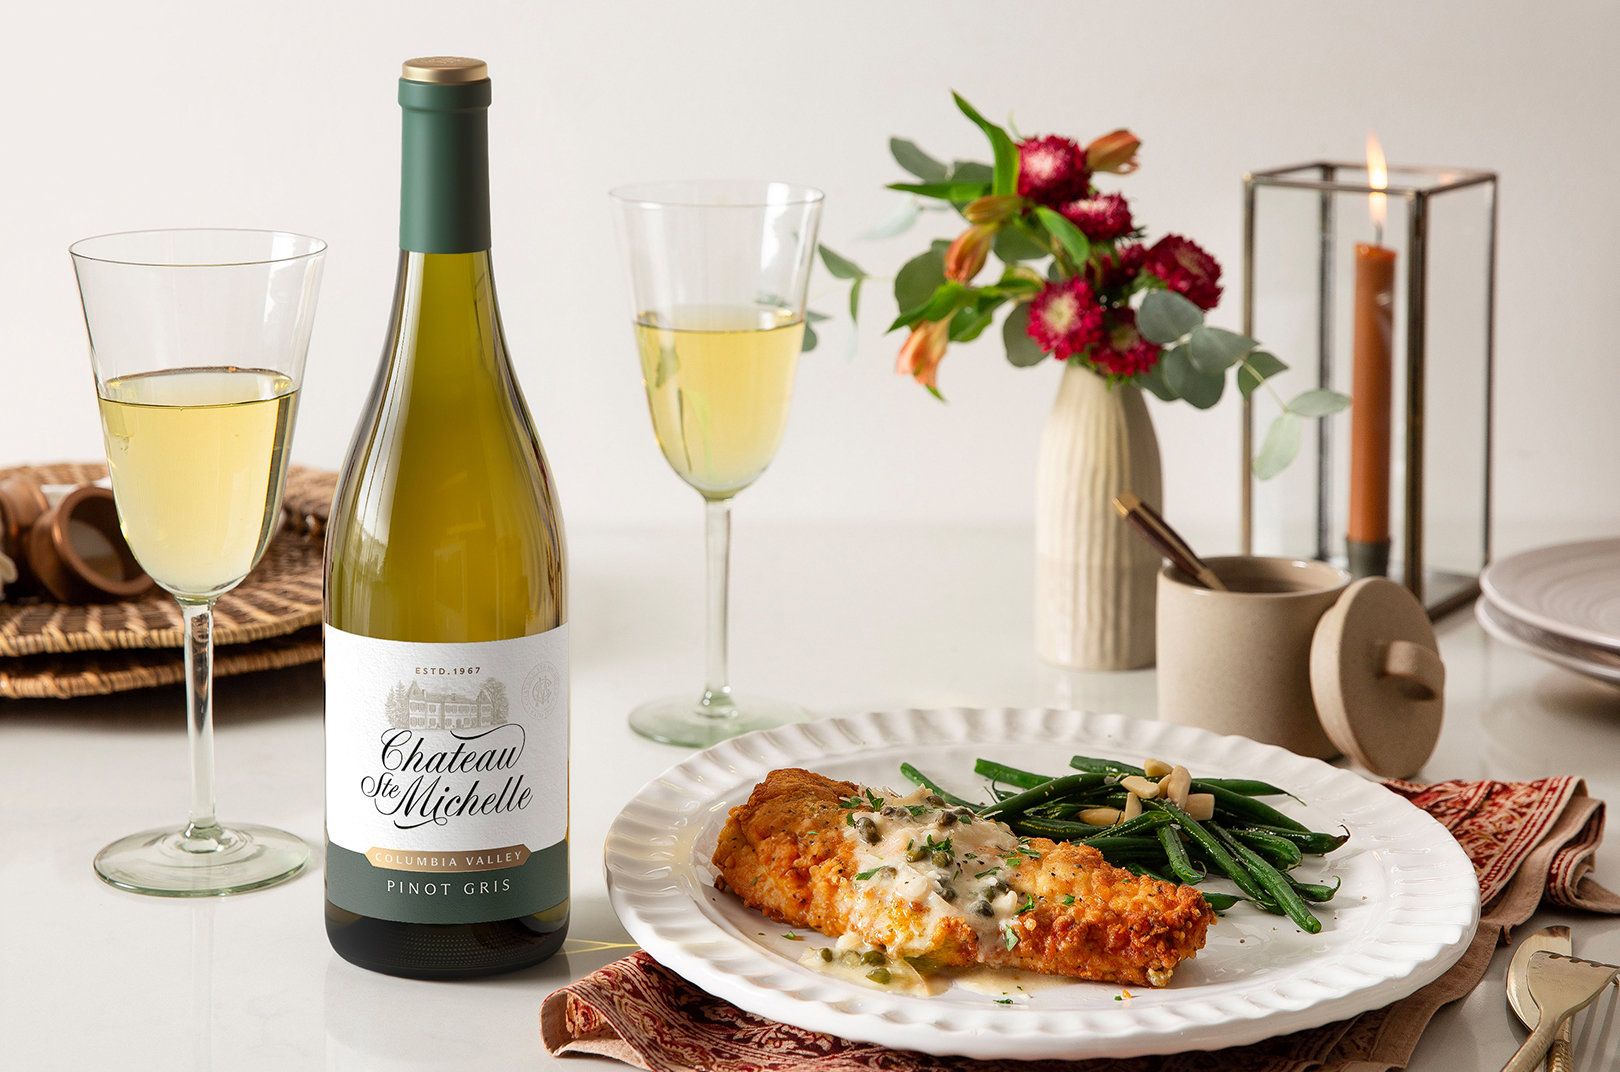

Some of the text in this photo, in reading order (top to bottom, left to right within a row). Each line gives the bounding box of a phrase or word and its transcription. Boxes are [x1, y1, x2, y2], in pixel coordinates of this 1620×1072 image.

[380, 723, 526, 773] Chateau
[361, 772, 533, 829] Ste Michelle
[375, 850, 522, 867] COLUMBIA VALLEY
[387, 878, 510, 896] PINOT GRIS
